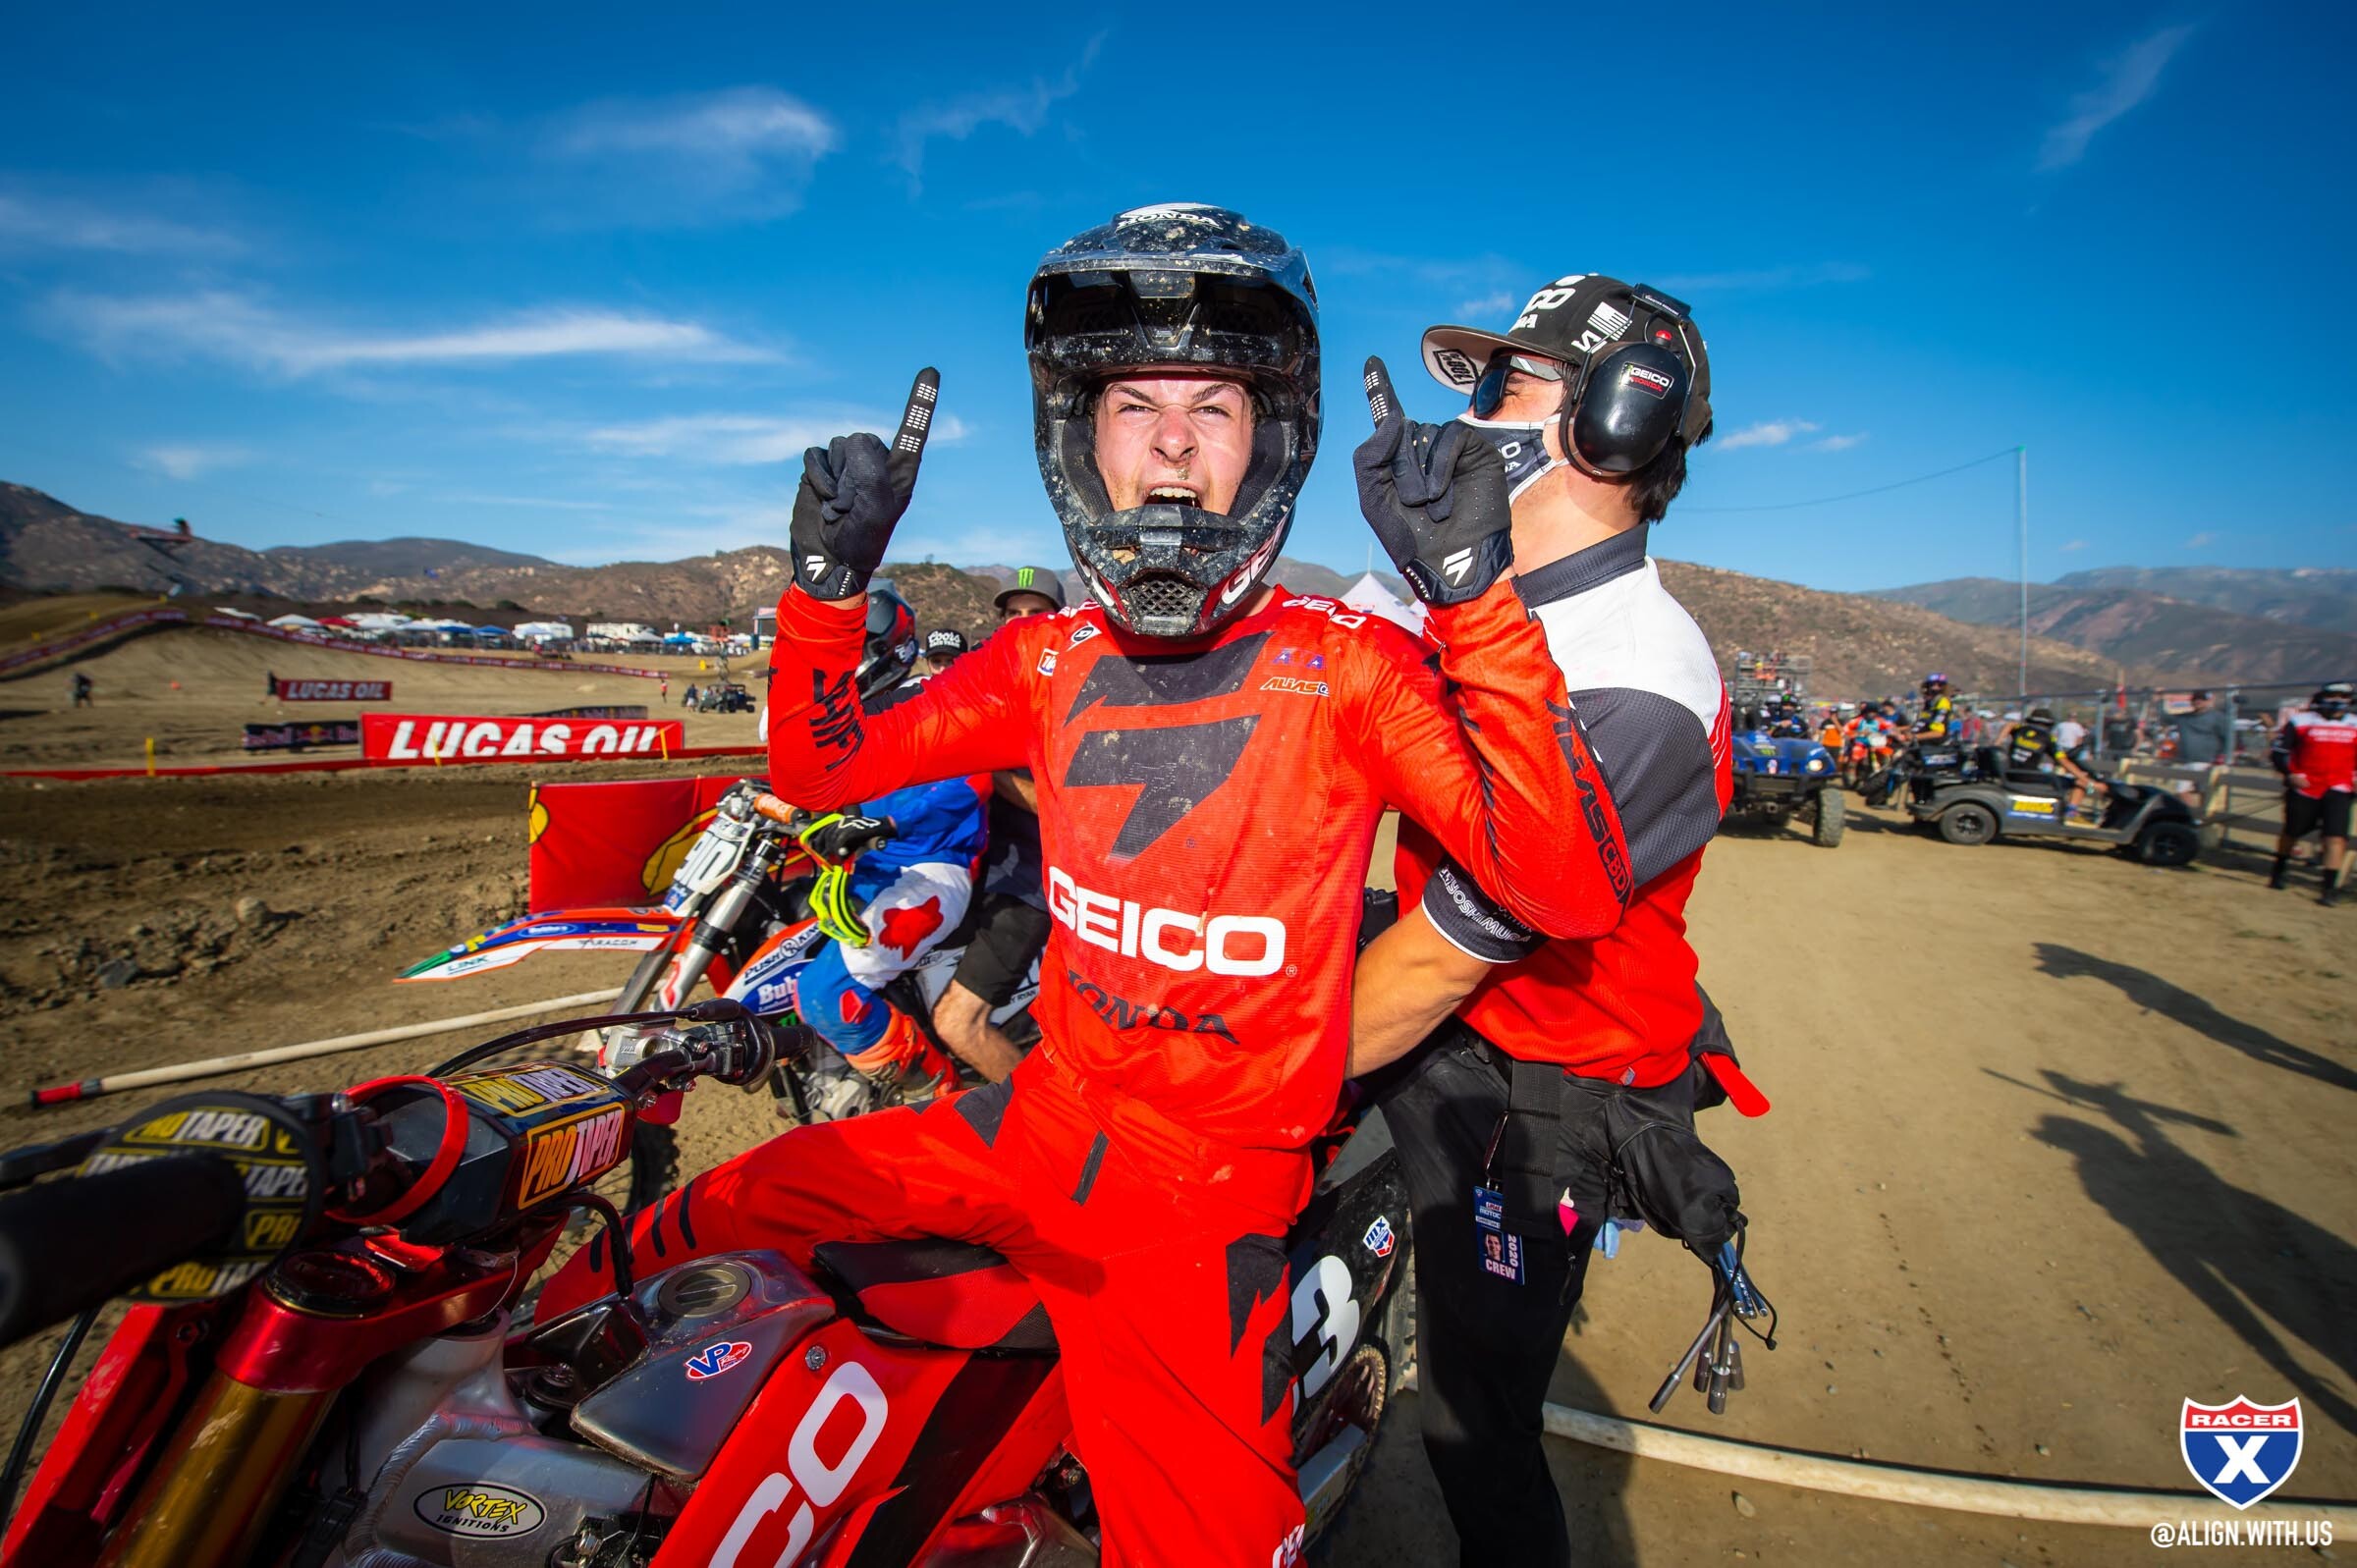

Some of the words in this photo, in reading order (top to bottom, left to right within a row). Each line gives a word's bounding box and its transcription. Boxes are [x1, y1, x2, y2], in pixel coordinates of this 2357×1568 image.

[1630, 366, 1670, 388] GEICO
[287, 681, 351, 700] LUCAS
[355, 680, 386, 699] OIL
[388, 720, 572, 759] LUCAS
[1599, 838, 1630, 895] CBD
[1048, 865, 1287, 977] GEICO
[1507, 1233, 1519, 1268] 2020
[1485, 1258, 1515, 1279] CREW
[686, 1343, 733, 1377] VP
[435, 1514, 511, 1533] IGNITIONS
[444, 1488, 528, 1525] VORTEX
